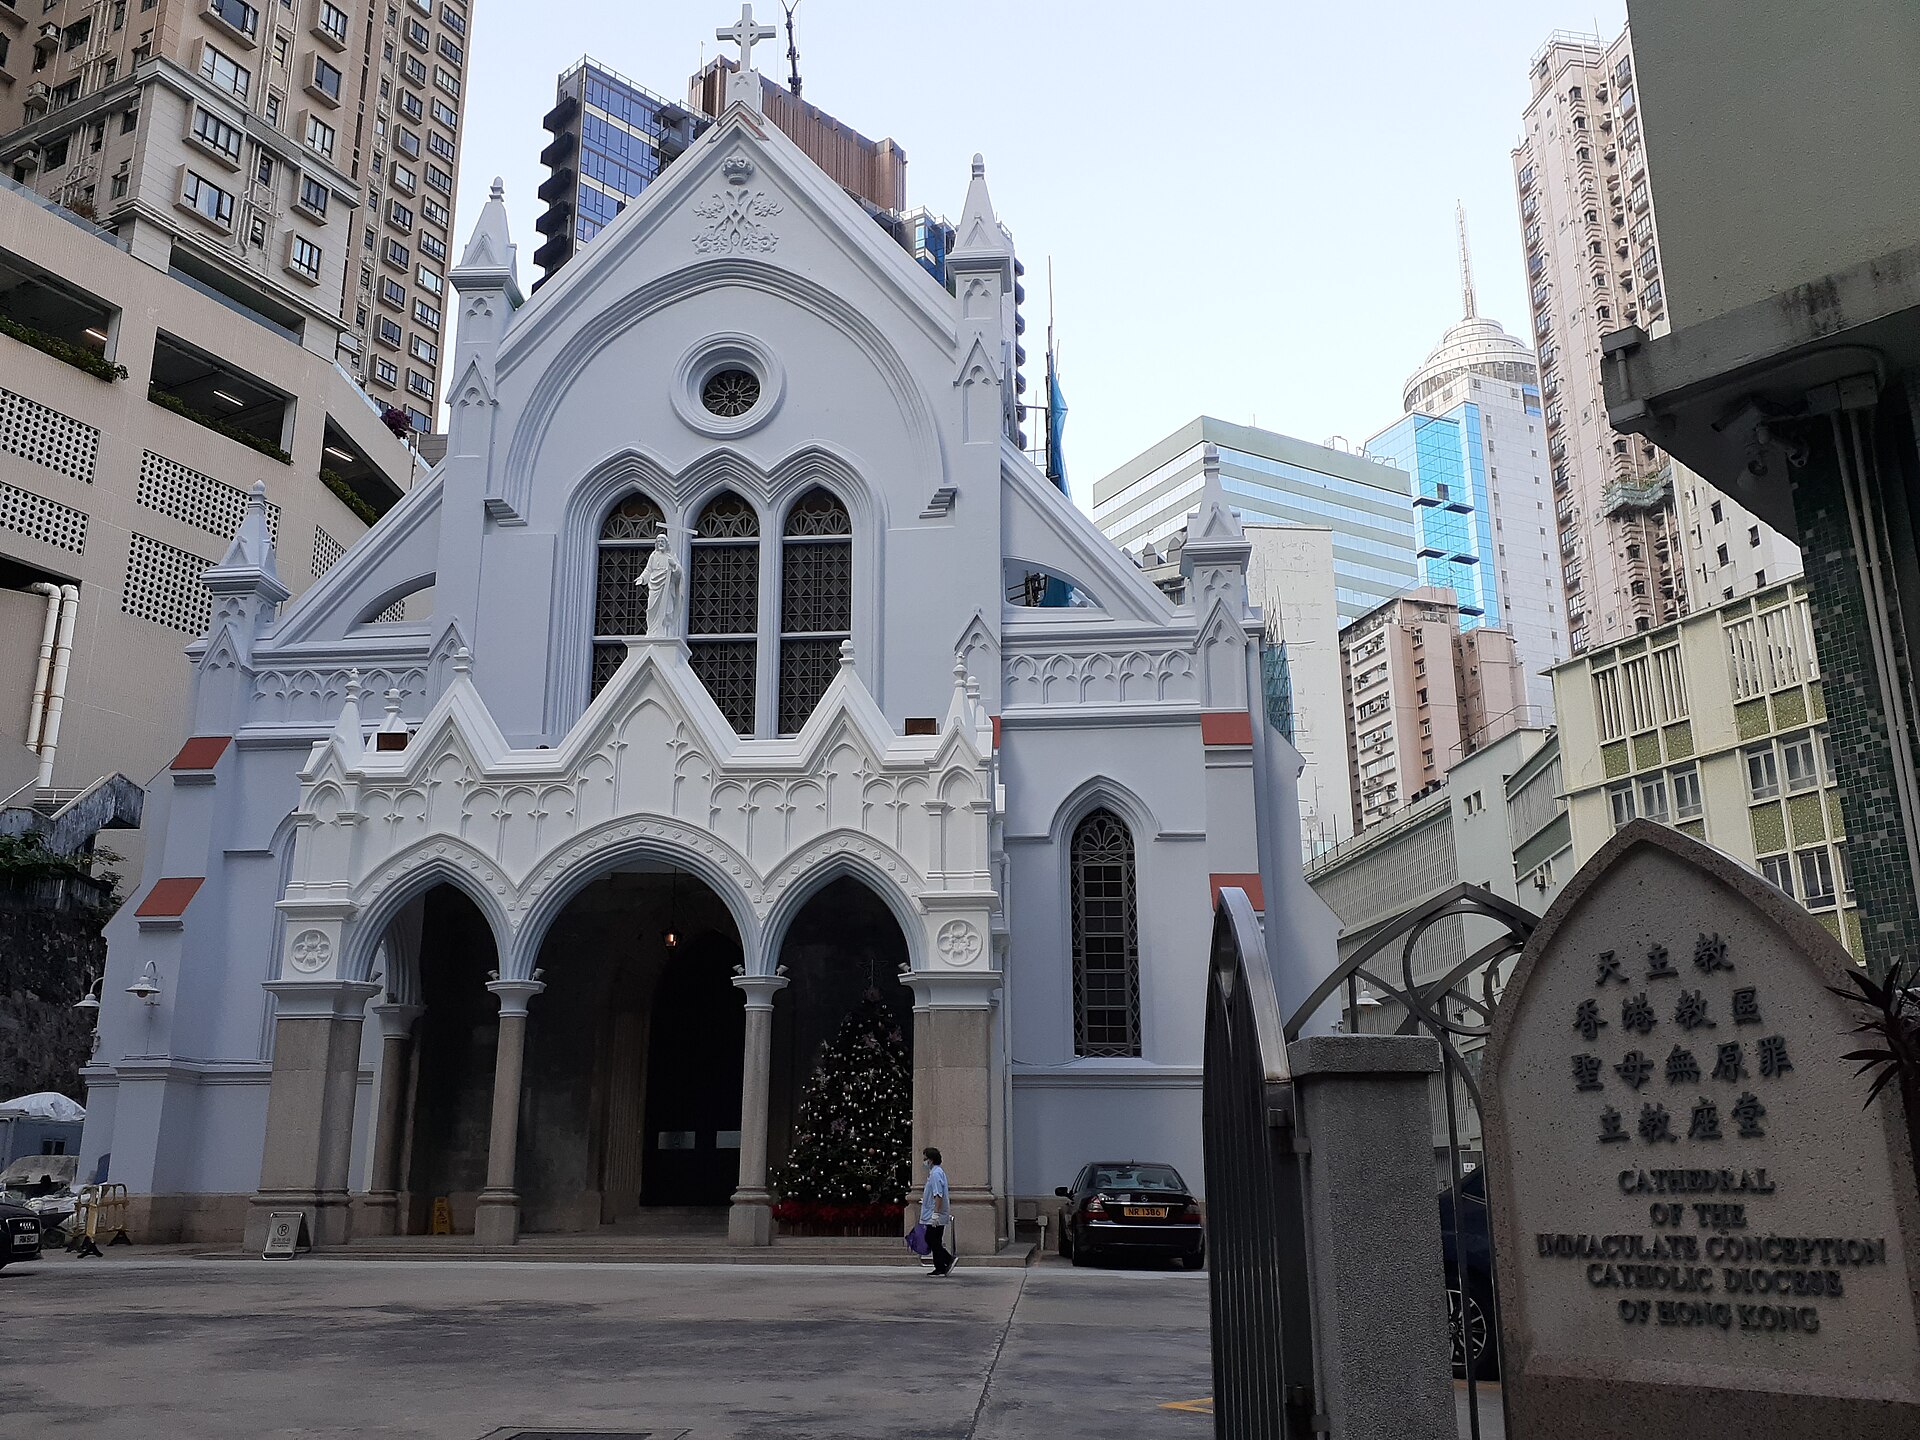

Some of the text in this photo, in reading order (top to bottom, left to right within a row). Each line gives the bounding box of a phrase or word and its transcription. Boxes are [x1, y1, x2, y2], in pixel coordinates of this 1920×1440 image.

[1595, 932, 1735, 986] 天主教
[1573, 986, 1762, 1041] 香港教區
[1571, 1035, 1795, 1092] 聖母無原罪
[1598, 1092, 1767, 1143] 主教座堂
[1618, 1168, 1776, 1195] CATHEDRAL
[1128, 1208, 1161, 1216] NR 1386
[1650, 1202, 1747, 1230] OF THE
[1536, 1233, 1886, 1266] IMMACULATE CONCEPTION
[1587, 1263, 1843, 1297] CATHOLIC DIOCESE
[1618, 1299, 1820, 1333] OF HONG KONG
